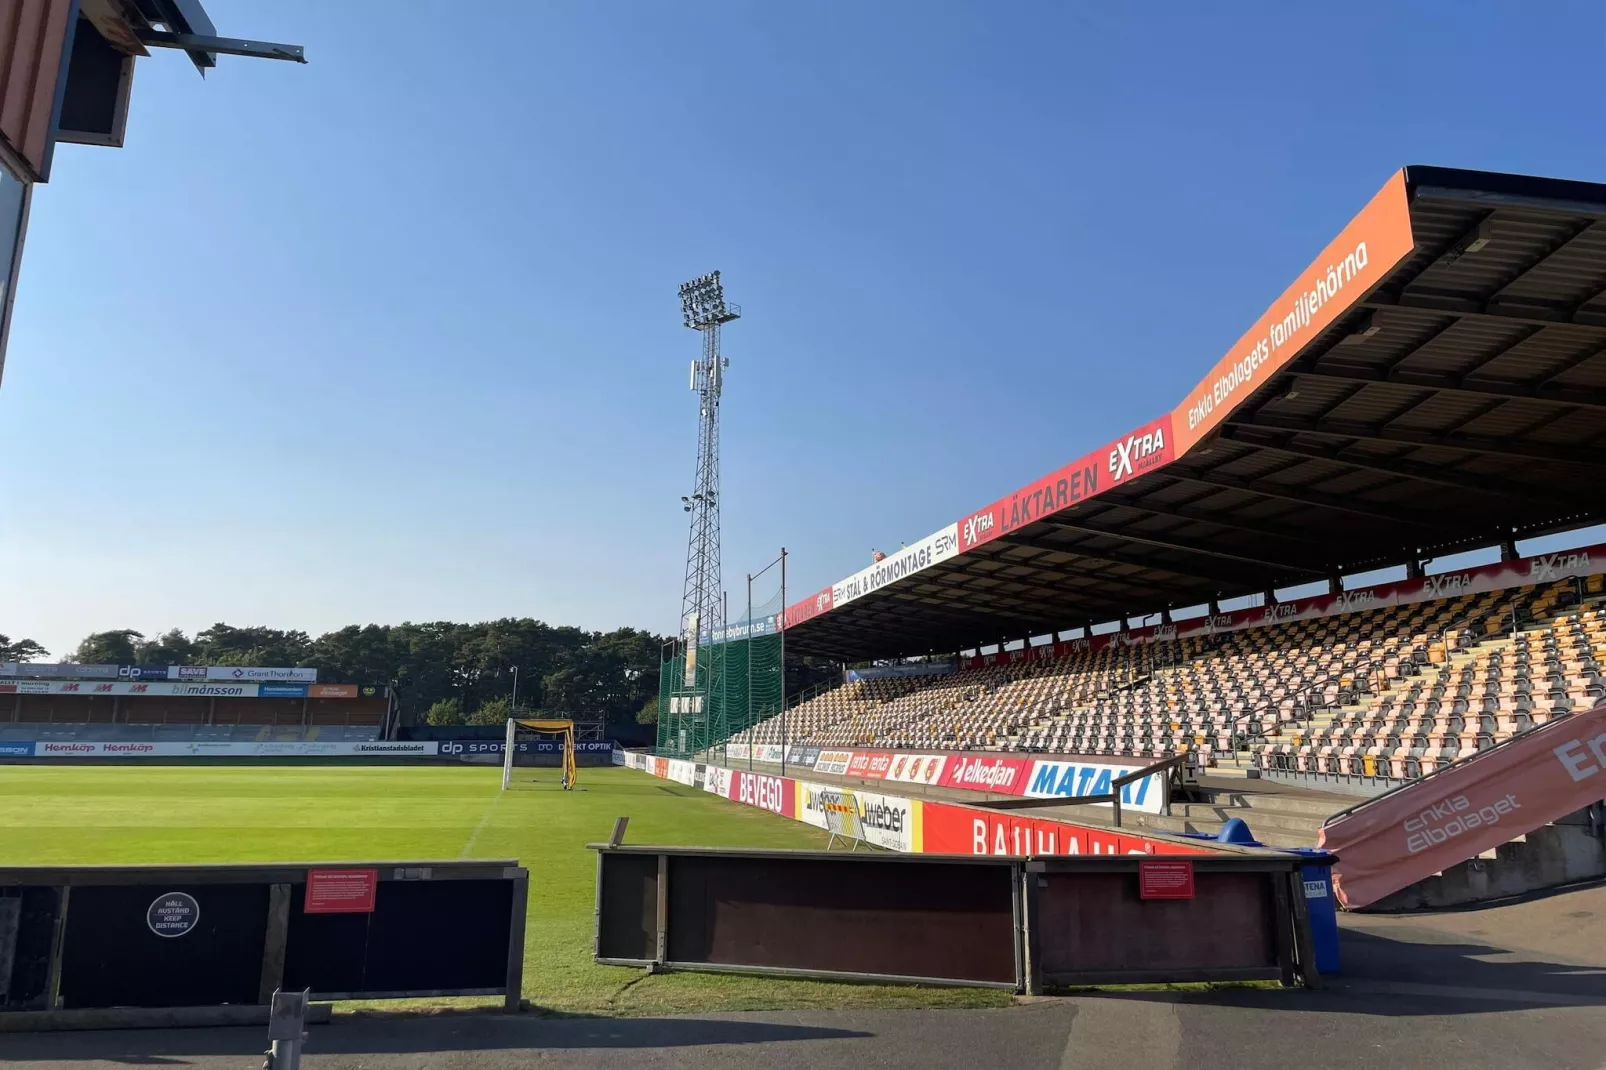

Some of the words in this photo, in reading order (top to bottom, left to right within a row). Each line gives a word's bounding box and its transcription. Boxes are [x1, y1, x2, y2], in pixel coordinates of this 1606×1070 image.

[1188, 396, 1213, 430] Enkla
[1213, 337, 1269, 407] Elbolagets
[1269, 241, 1368, 352] familjehörna
[1109, 428, 1165, 481] EXTRA
[1000, 463, 1099, 532] LÄKTAREN
[963, 511, 995, 546] EXTRA
[936, 532, 957, 556] SRM
[847, 577, 862, 600] STÅL
[863, 576, 869, 593] &
[870, 545, 932, 590] RÖRMONTAGE
[1530, 552, 1591, 581] EXTRA
[1422, 573, 1471, 598] EXTRA
[1336, 590, 1376, 612] EXTRA
[1205, 615, 1233, 634] EXTRA
[1265, 604, 1298, 624] EXTRA
[119, 664, 142, 679] dp
[180, 667, 206, 675] SAVE
[45, 743, 95, 753] Hemköp
[103, 743, 153, 753] Hemköp
[361, 743, 424, 752] Kristianstadsbladet
[441, 740, 464, 755] dp
[588, 743, 611, 751] OPTIK
[739, 772, 783, 814] BEVEGO
[866, 796, 907, 834] weber
[1407, 793, 1521, 853] Elbolaget
